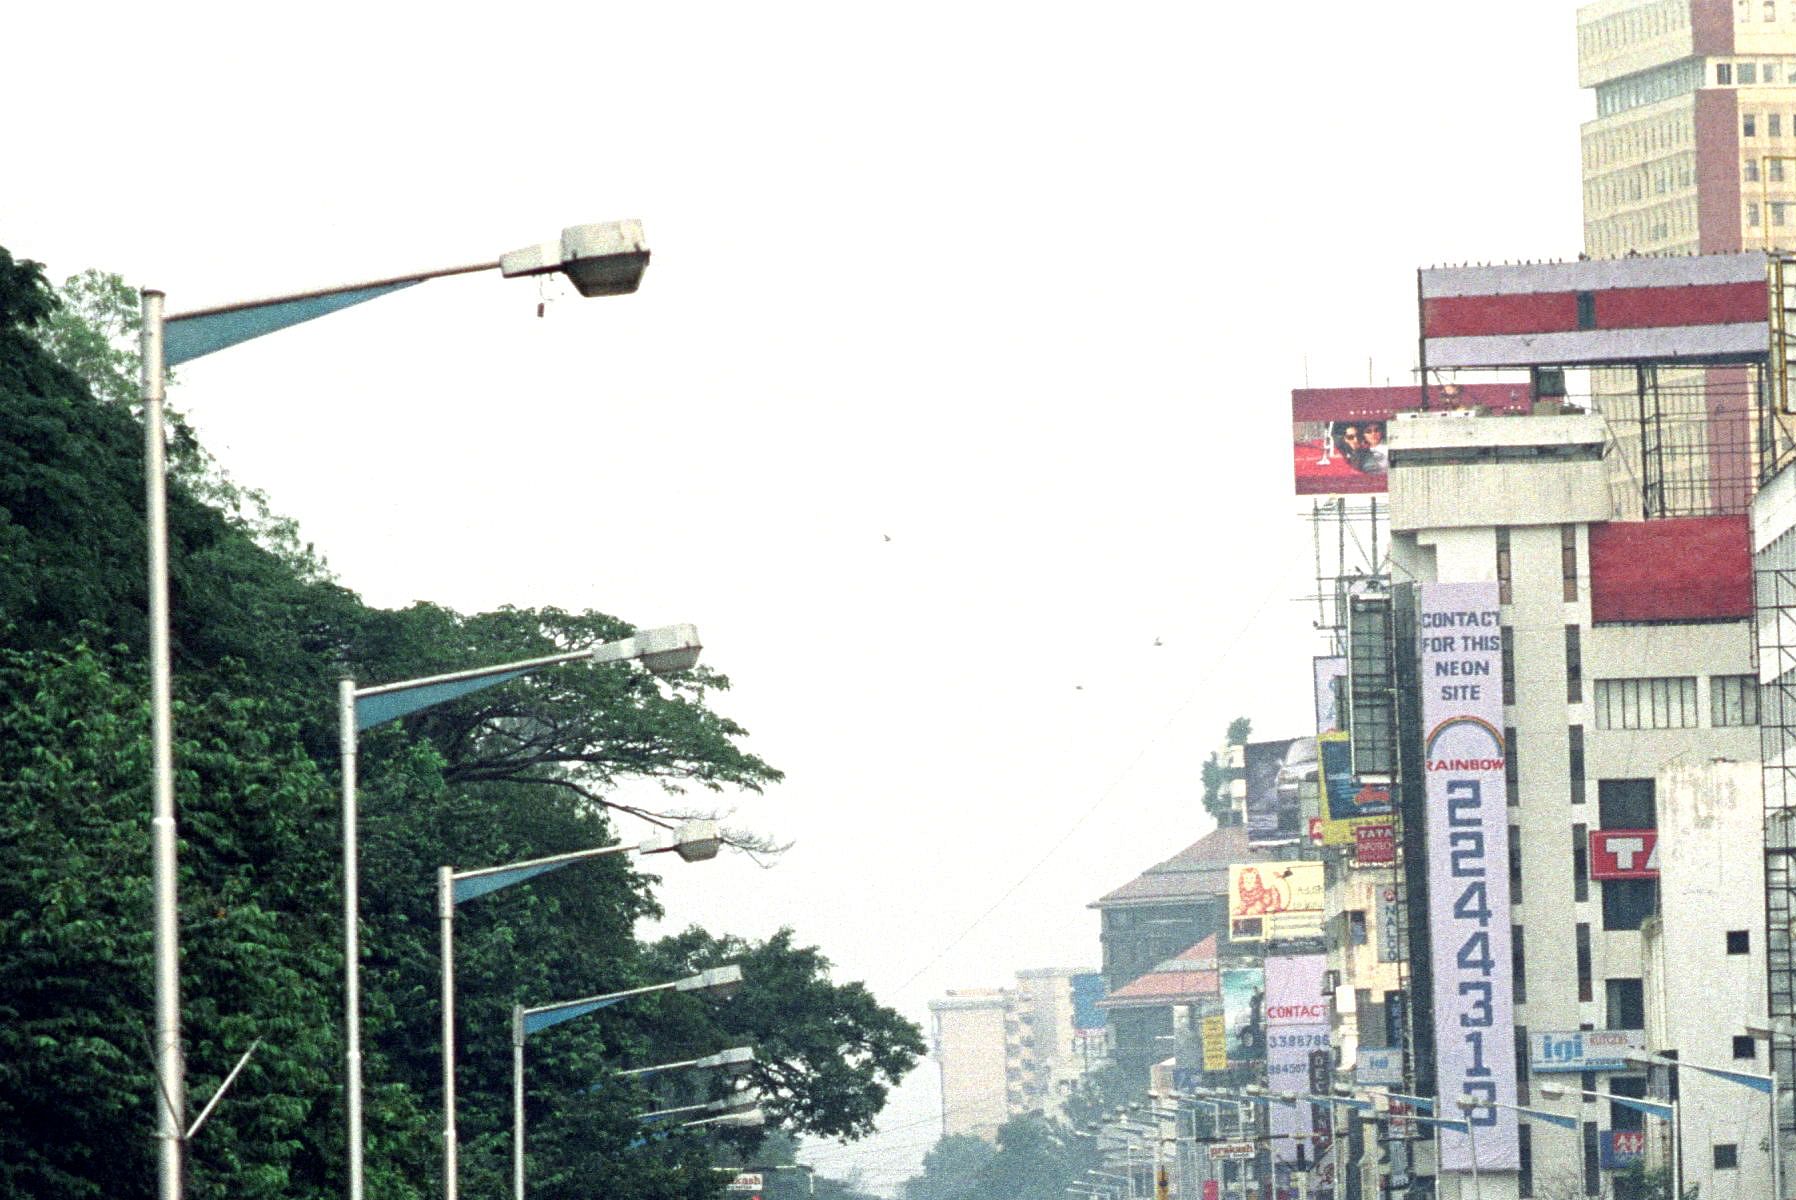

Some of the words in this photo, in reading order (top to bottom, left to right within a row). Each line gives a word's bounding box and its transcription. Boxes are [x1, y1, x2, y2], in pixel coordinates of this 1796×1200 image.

[1423, 612, 1500, 628] CONTACT
[1423, 638, 1455, 653] FOR
[1462, 636, 1500, 651] THIS
[1435, 661, 1490, 676] NEON
[1441, 685, 1481, 701] SITE
[1425, 759, 1505, 772] RAINBOW
[1359, 829, 1393, 838] TATA
[1267, 1004, 1328, 1019] CONTACT
